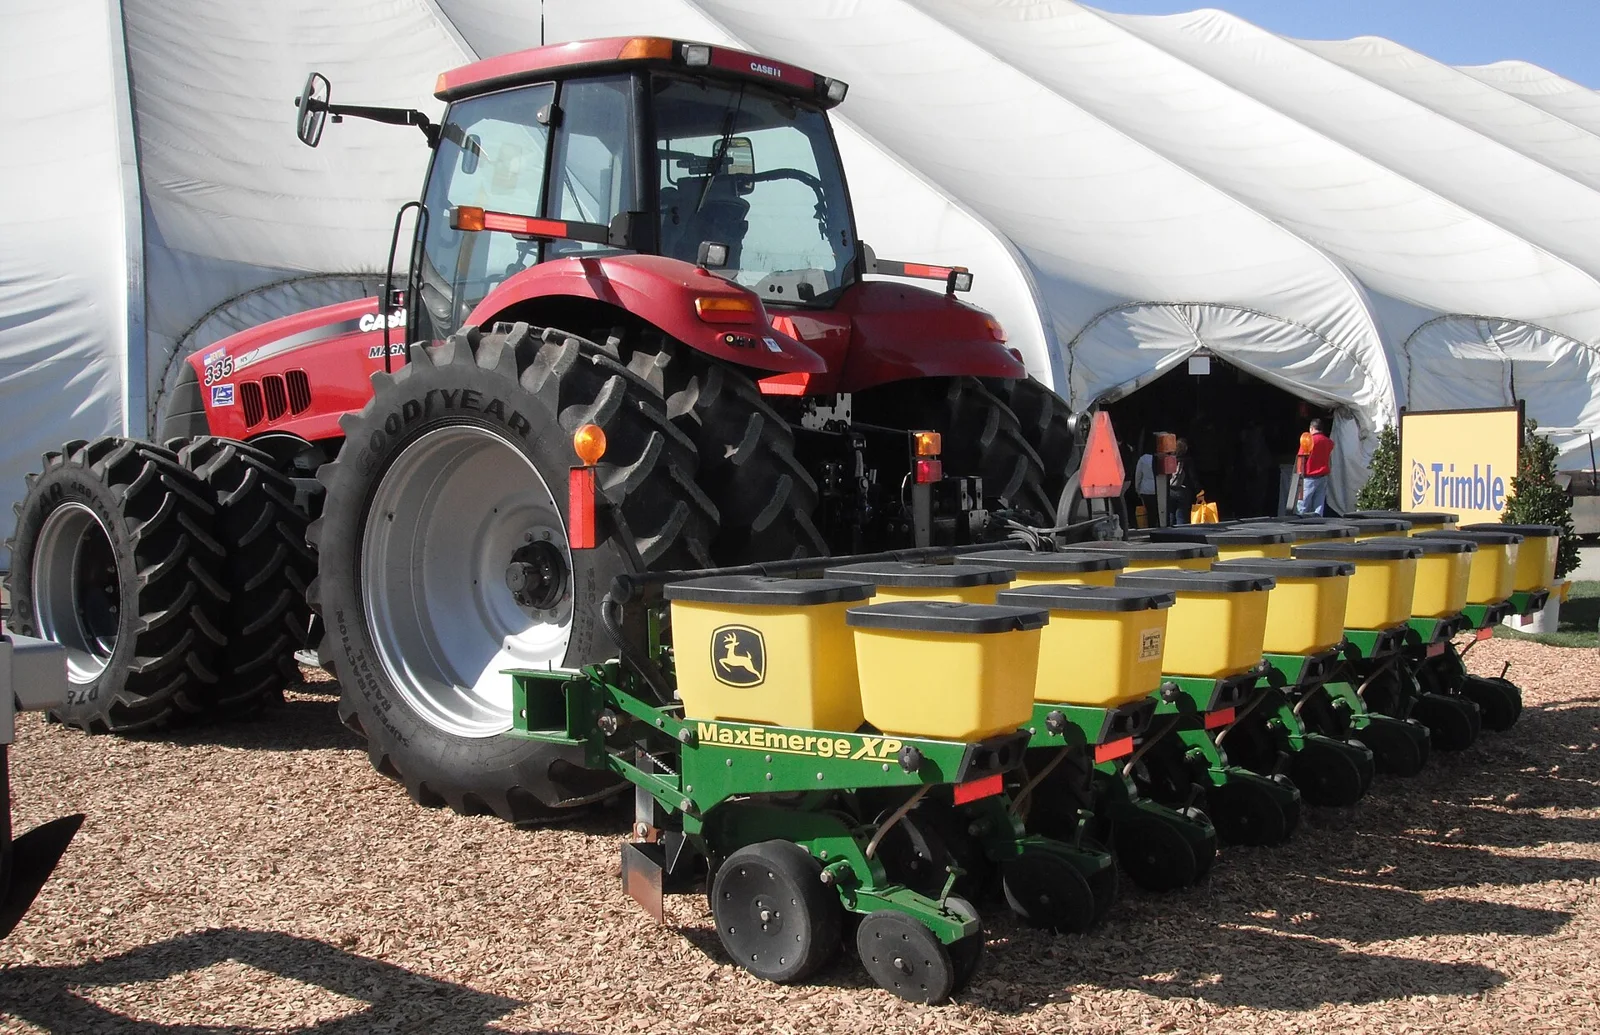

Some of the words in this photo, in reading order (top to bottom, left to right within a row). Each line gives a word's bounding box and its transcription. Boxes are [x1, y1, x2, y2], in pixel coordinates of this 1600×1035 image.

[204, 355, 234, 387] 335
[1431, 463, 1505, 511] Trimble
[356, 648, 393, 713] RADIAL
[697, 722, 852, 759] MaxEmerge
[850, 736, 904, 761] XP
